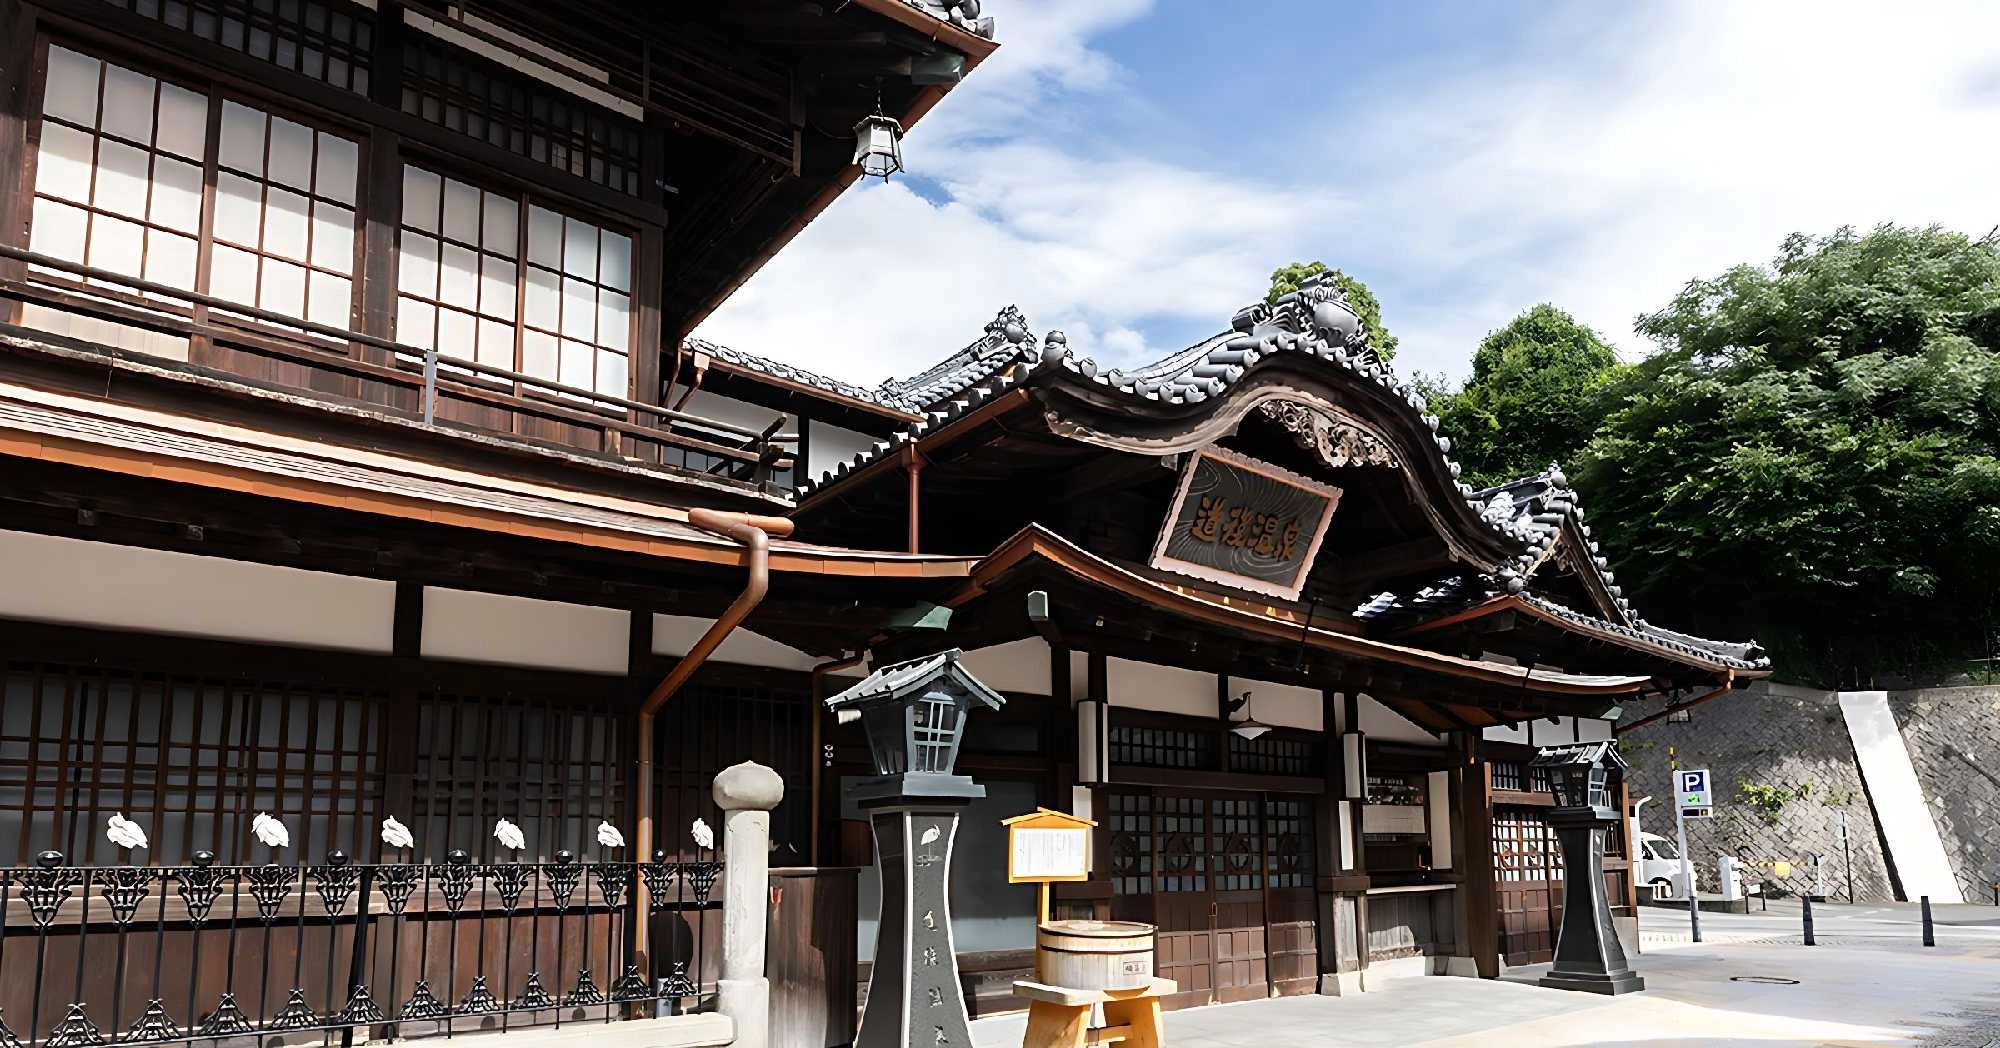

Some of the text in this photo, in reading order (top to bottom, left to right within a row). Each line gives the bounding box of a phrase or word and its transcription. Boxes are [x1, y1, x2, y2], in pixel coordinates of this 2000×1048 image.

[1191, 495, 1301, 562] 道後温泉
[1685, 774, 1700, 791] P
